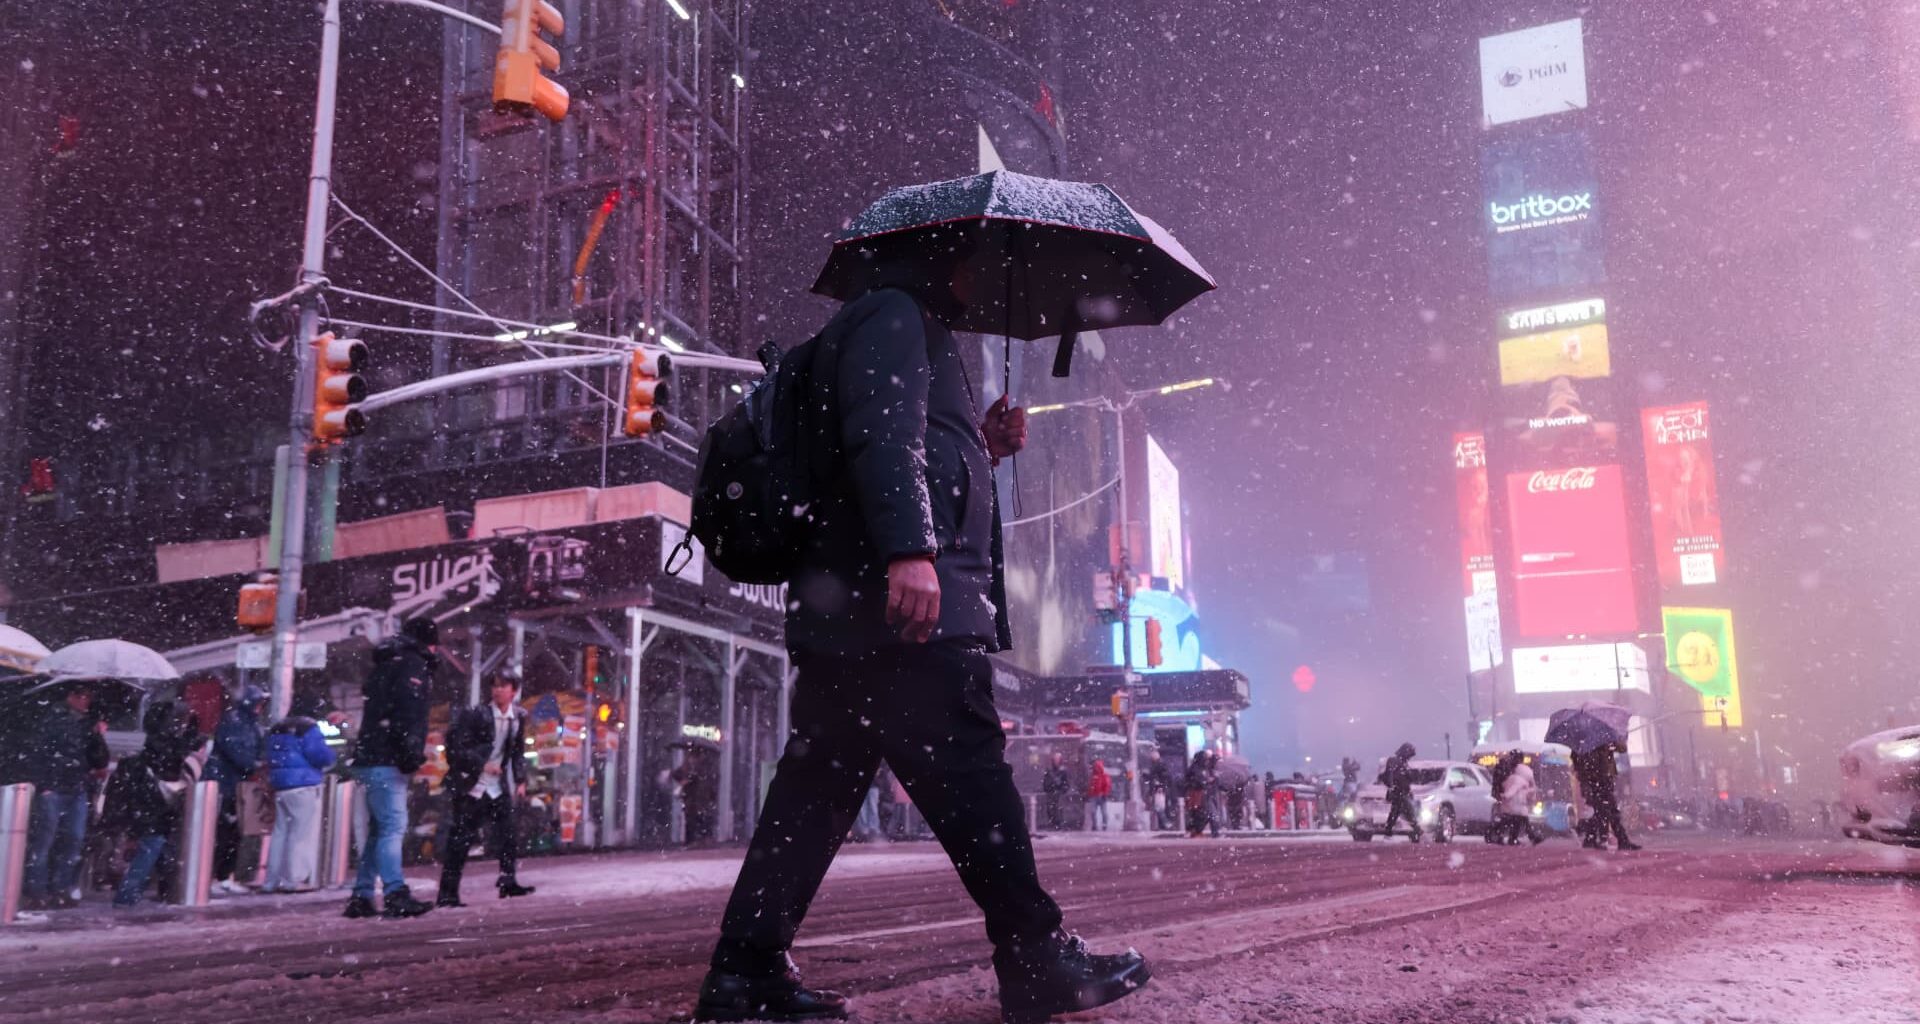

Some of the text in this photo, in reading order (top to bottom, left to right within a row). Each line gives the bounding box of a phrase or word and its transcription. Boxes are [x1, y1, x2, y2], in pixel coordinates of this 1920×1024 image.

[1528, 61, 1568, 80] PGIM
[1491, 192, 1591, 224] britbox
[1529, 414, 1588, 429] No worries
